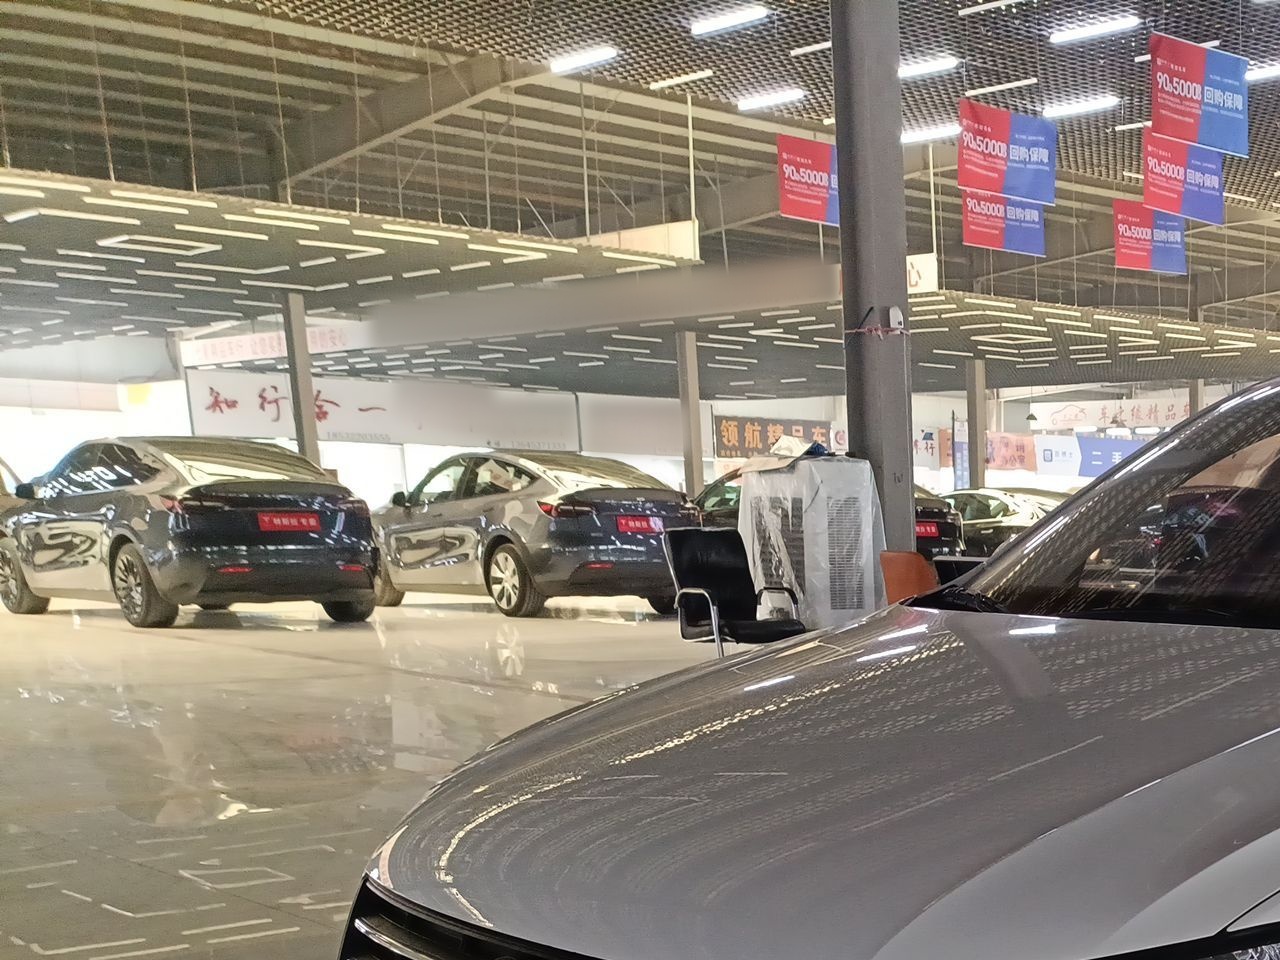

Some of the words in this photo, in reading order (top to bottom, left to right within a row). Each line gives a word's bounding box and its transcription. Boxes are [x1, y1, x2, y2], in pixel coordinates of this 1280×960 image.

[1204, 86, 1243, 111] 回购保障
[1009, 144, 1049, 164] 回购保障
